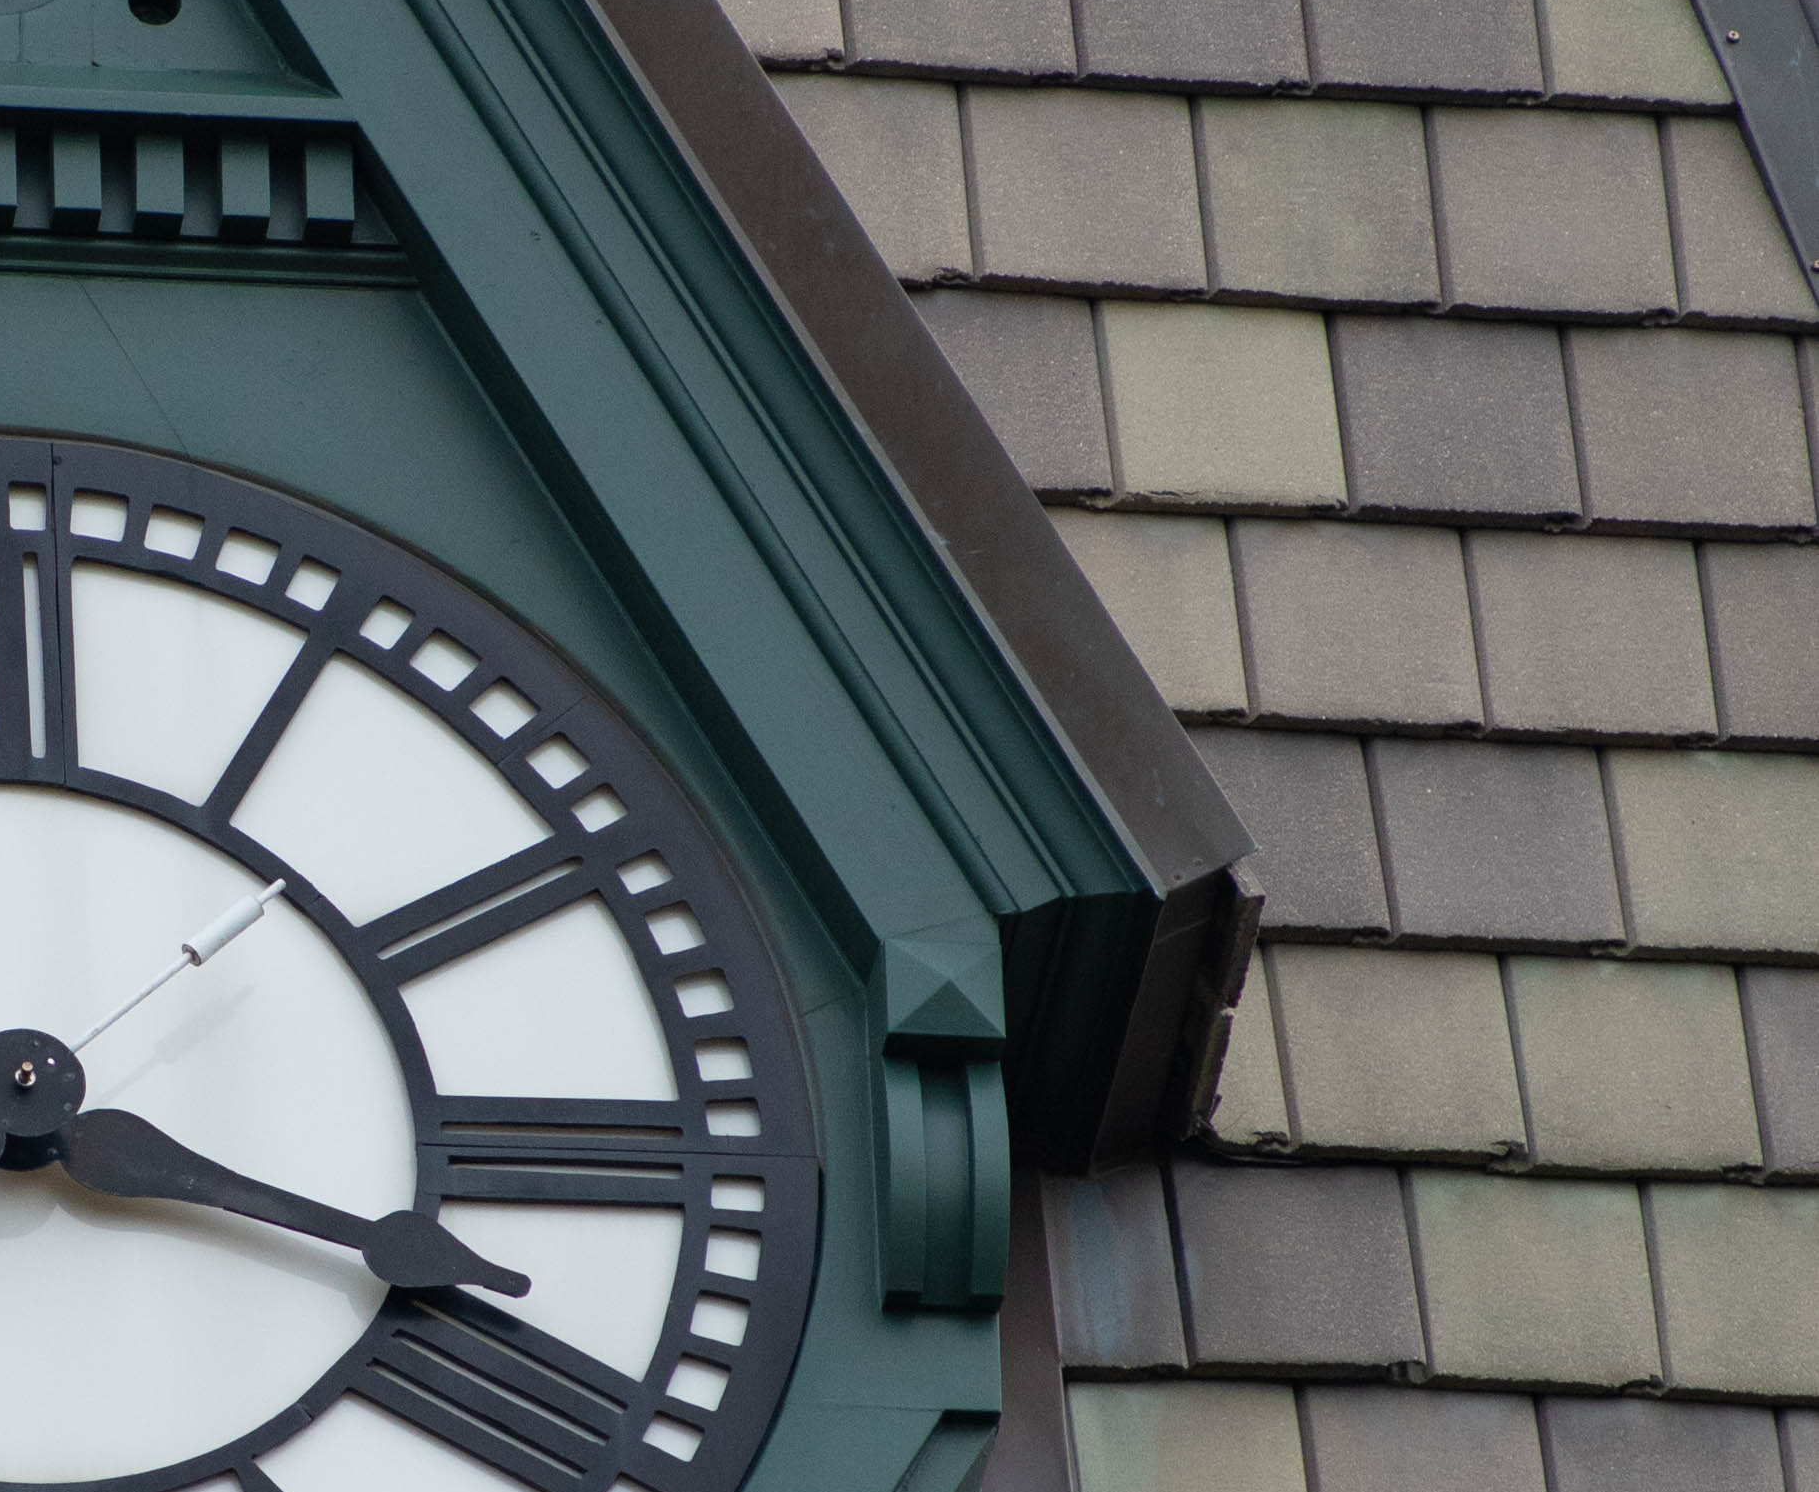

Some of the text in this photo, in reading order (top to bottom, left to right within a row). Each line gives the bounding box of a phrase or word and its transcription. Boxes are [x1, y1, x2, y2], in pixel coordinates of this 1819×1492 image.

[203, 627, 357, 820] I
[354, 837, 606, 977] II
[422, 1096, 685, 1203] III
